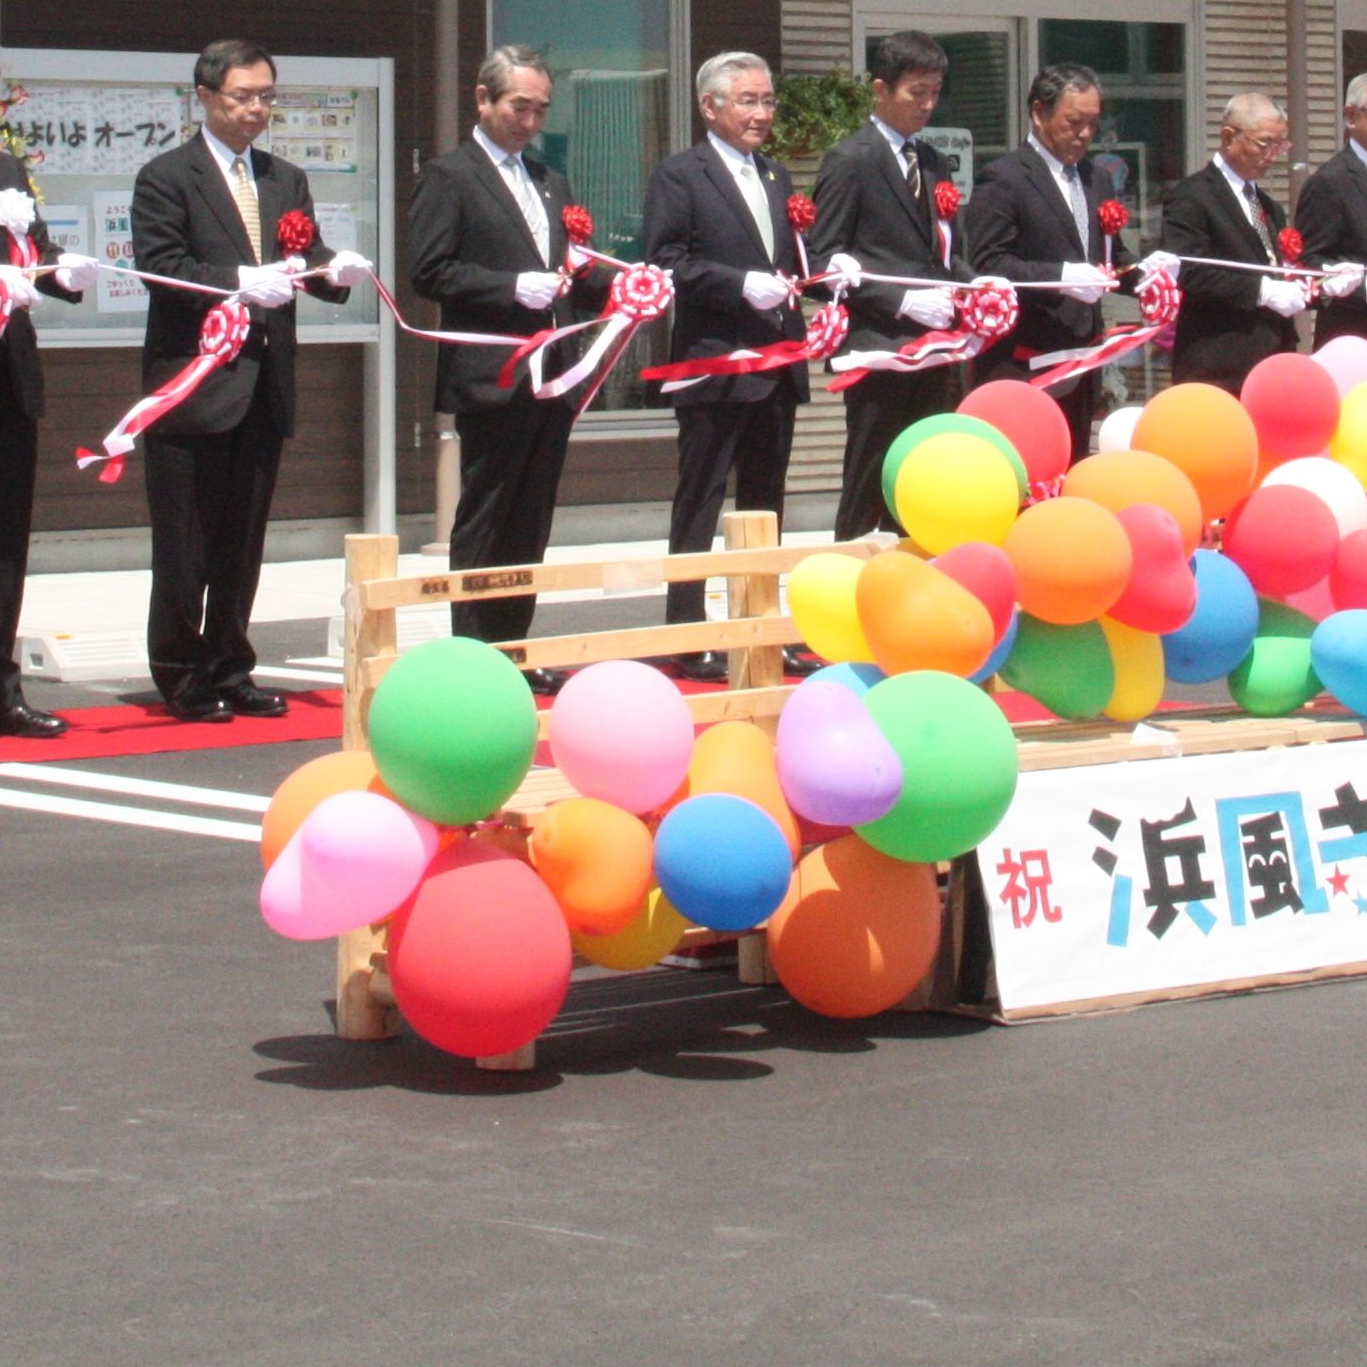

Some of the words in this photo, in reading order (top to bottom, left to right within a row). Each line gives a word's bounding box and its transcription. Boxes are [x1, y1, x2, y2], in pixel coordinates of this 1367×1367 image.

[94, 121, 176, 148] オープン
[996, 847, 1063, 930] 祝
